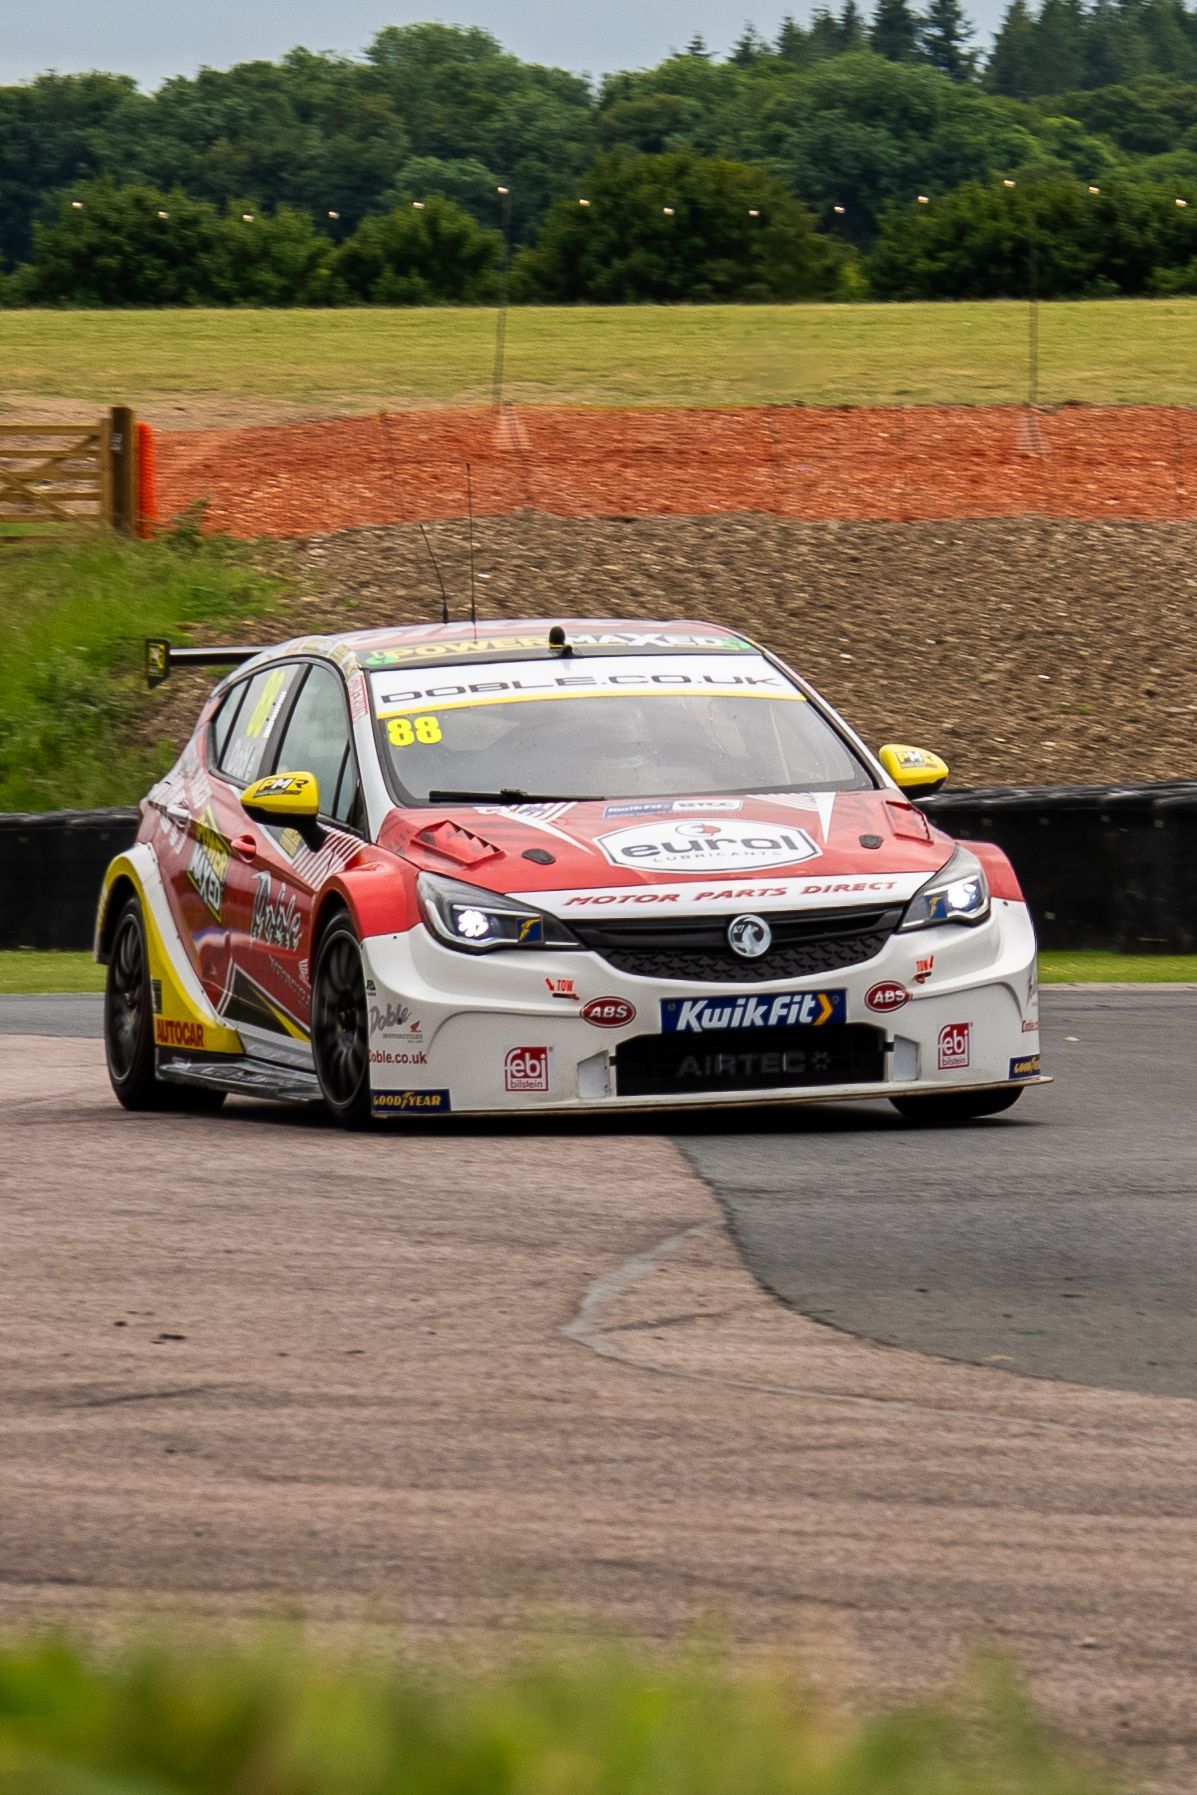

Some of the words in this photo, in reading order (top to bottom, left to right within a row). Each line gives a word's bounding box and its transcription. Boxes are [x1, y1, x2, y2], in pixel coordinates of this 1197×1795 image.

[386, 637, 552, 660] POWER
[564, 632, 723, 648] MAXED
[381, 674, 782, 704] DOBLE.CO.UK
[387, 716, 442, 747] 88
[257, 777, 309, 792] PMR
[620, 834, 800, 858] eurol
[652, 850, 783, 863] LUBRICANTS
[565, 892, 681, 906] MOTOR
[697, 886, 788, 900] PARTS
[800, 880, 898, 895] DIRECT
[873, 989, 906, 1004] ABS
[368, 1003, 412, 1037] Doble
[588, 1006, 628, 1018] ABS
[156, 1019, 205, 1048] AUTOCAR
[938, 1027, 968, 1056] febi
[504, 1048, 548, 1078] febi
[675, 1050, 807, 1078] AIRTEC
[510, 1079, 544, 1089] bilstein
[373, 1094, 441, 1107] GOODYEAR
